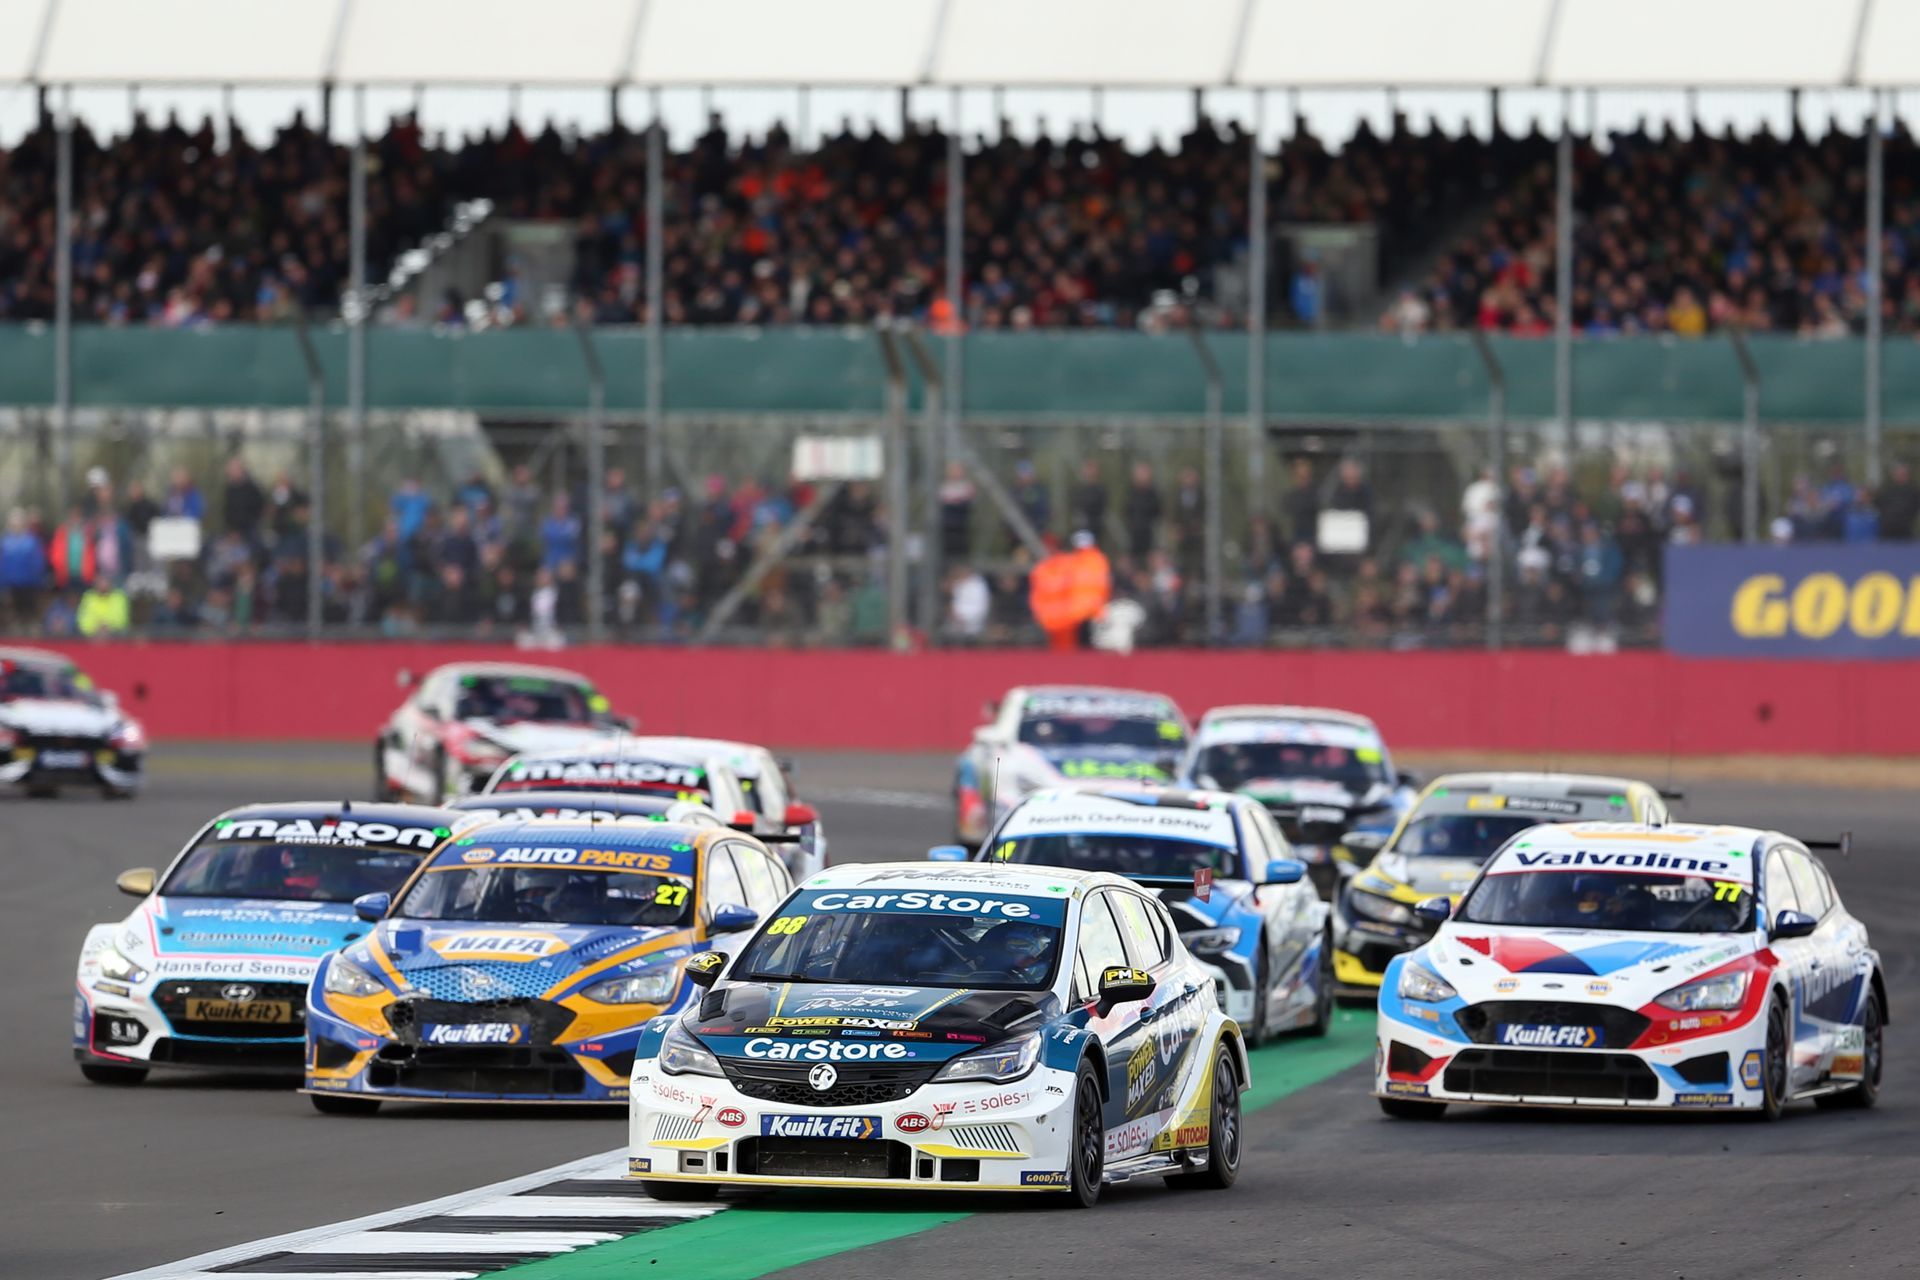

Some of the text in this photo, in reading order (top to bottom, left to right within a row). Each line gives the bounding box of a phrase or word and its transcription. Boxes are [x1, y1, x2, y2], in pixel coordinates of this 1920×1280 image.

[498, 848, 672, 869] AUTO PARTS
[1516, 851, 1729, 872] Valvoline
[655, 884, 688, 906] 27
[1714, 881, 1742, 902] 77
[767, 916, 807, 934] 88
[449, 937, 546, 953] NAPA
[155, 960, 243, 975] Hansford
[771, 1017, 914, 1030] POWER MAXED
[1045, 1085, 1064, 1094] JFA
[1127, 1058, 1155, 1108] MAXED
[719, 1113, 742, 1123] ABS
[900, 1117, 926, 1128] ABS
[1176, 1125, 1208, 1145] AUTOCAR
